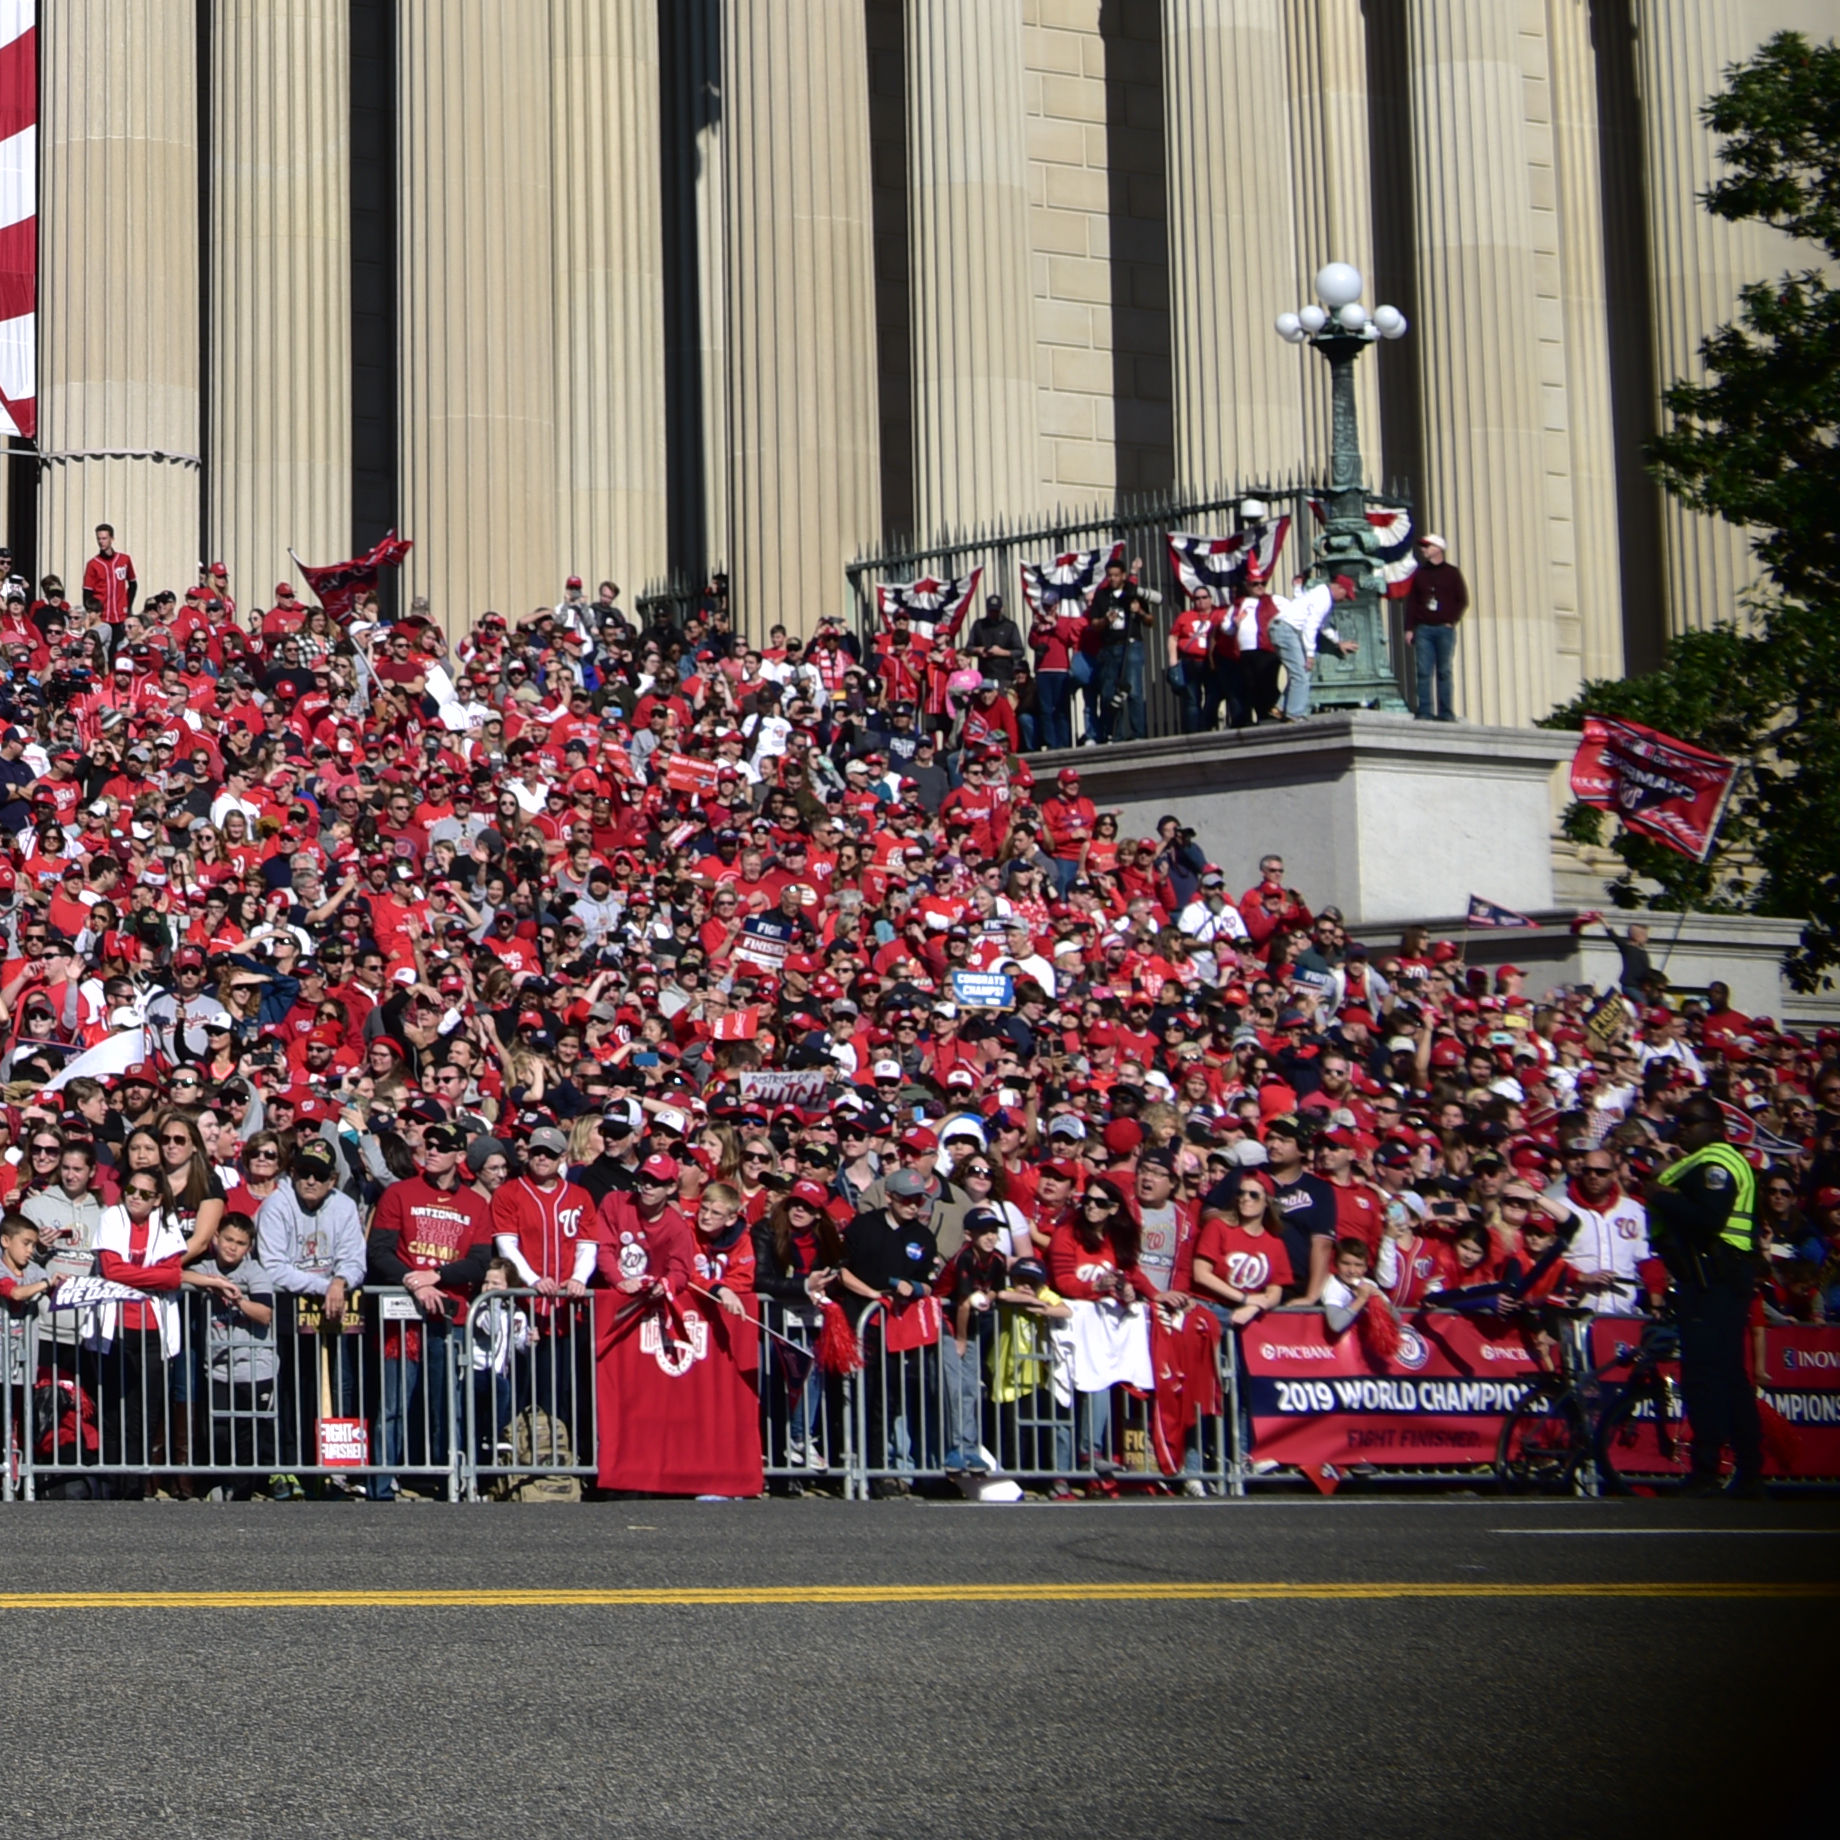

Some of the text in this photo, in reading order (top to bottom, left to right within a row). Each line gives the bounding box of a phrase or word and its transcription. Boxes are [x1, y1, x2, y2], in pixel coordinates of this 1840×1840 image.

[957, 973, 1006, 986] CONGRATS
[962, 985, 1004, 998] CHAMPS!
[410, 1206, 471, 1226] NATIONALS
[416, 1217, 464, 1236] WORLD
[416, 1229, 458, 1248] SERIES
[59, 1276, 93, 1290] AND
[56, 1286, 143, 1306] WE DANCE
[1274, 1380, 1334, 1411] 2019
[1332, 1380, 1417, 1411] WORLD
[1348, 1428, 1394, 1448] FIGHT
